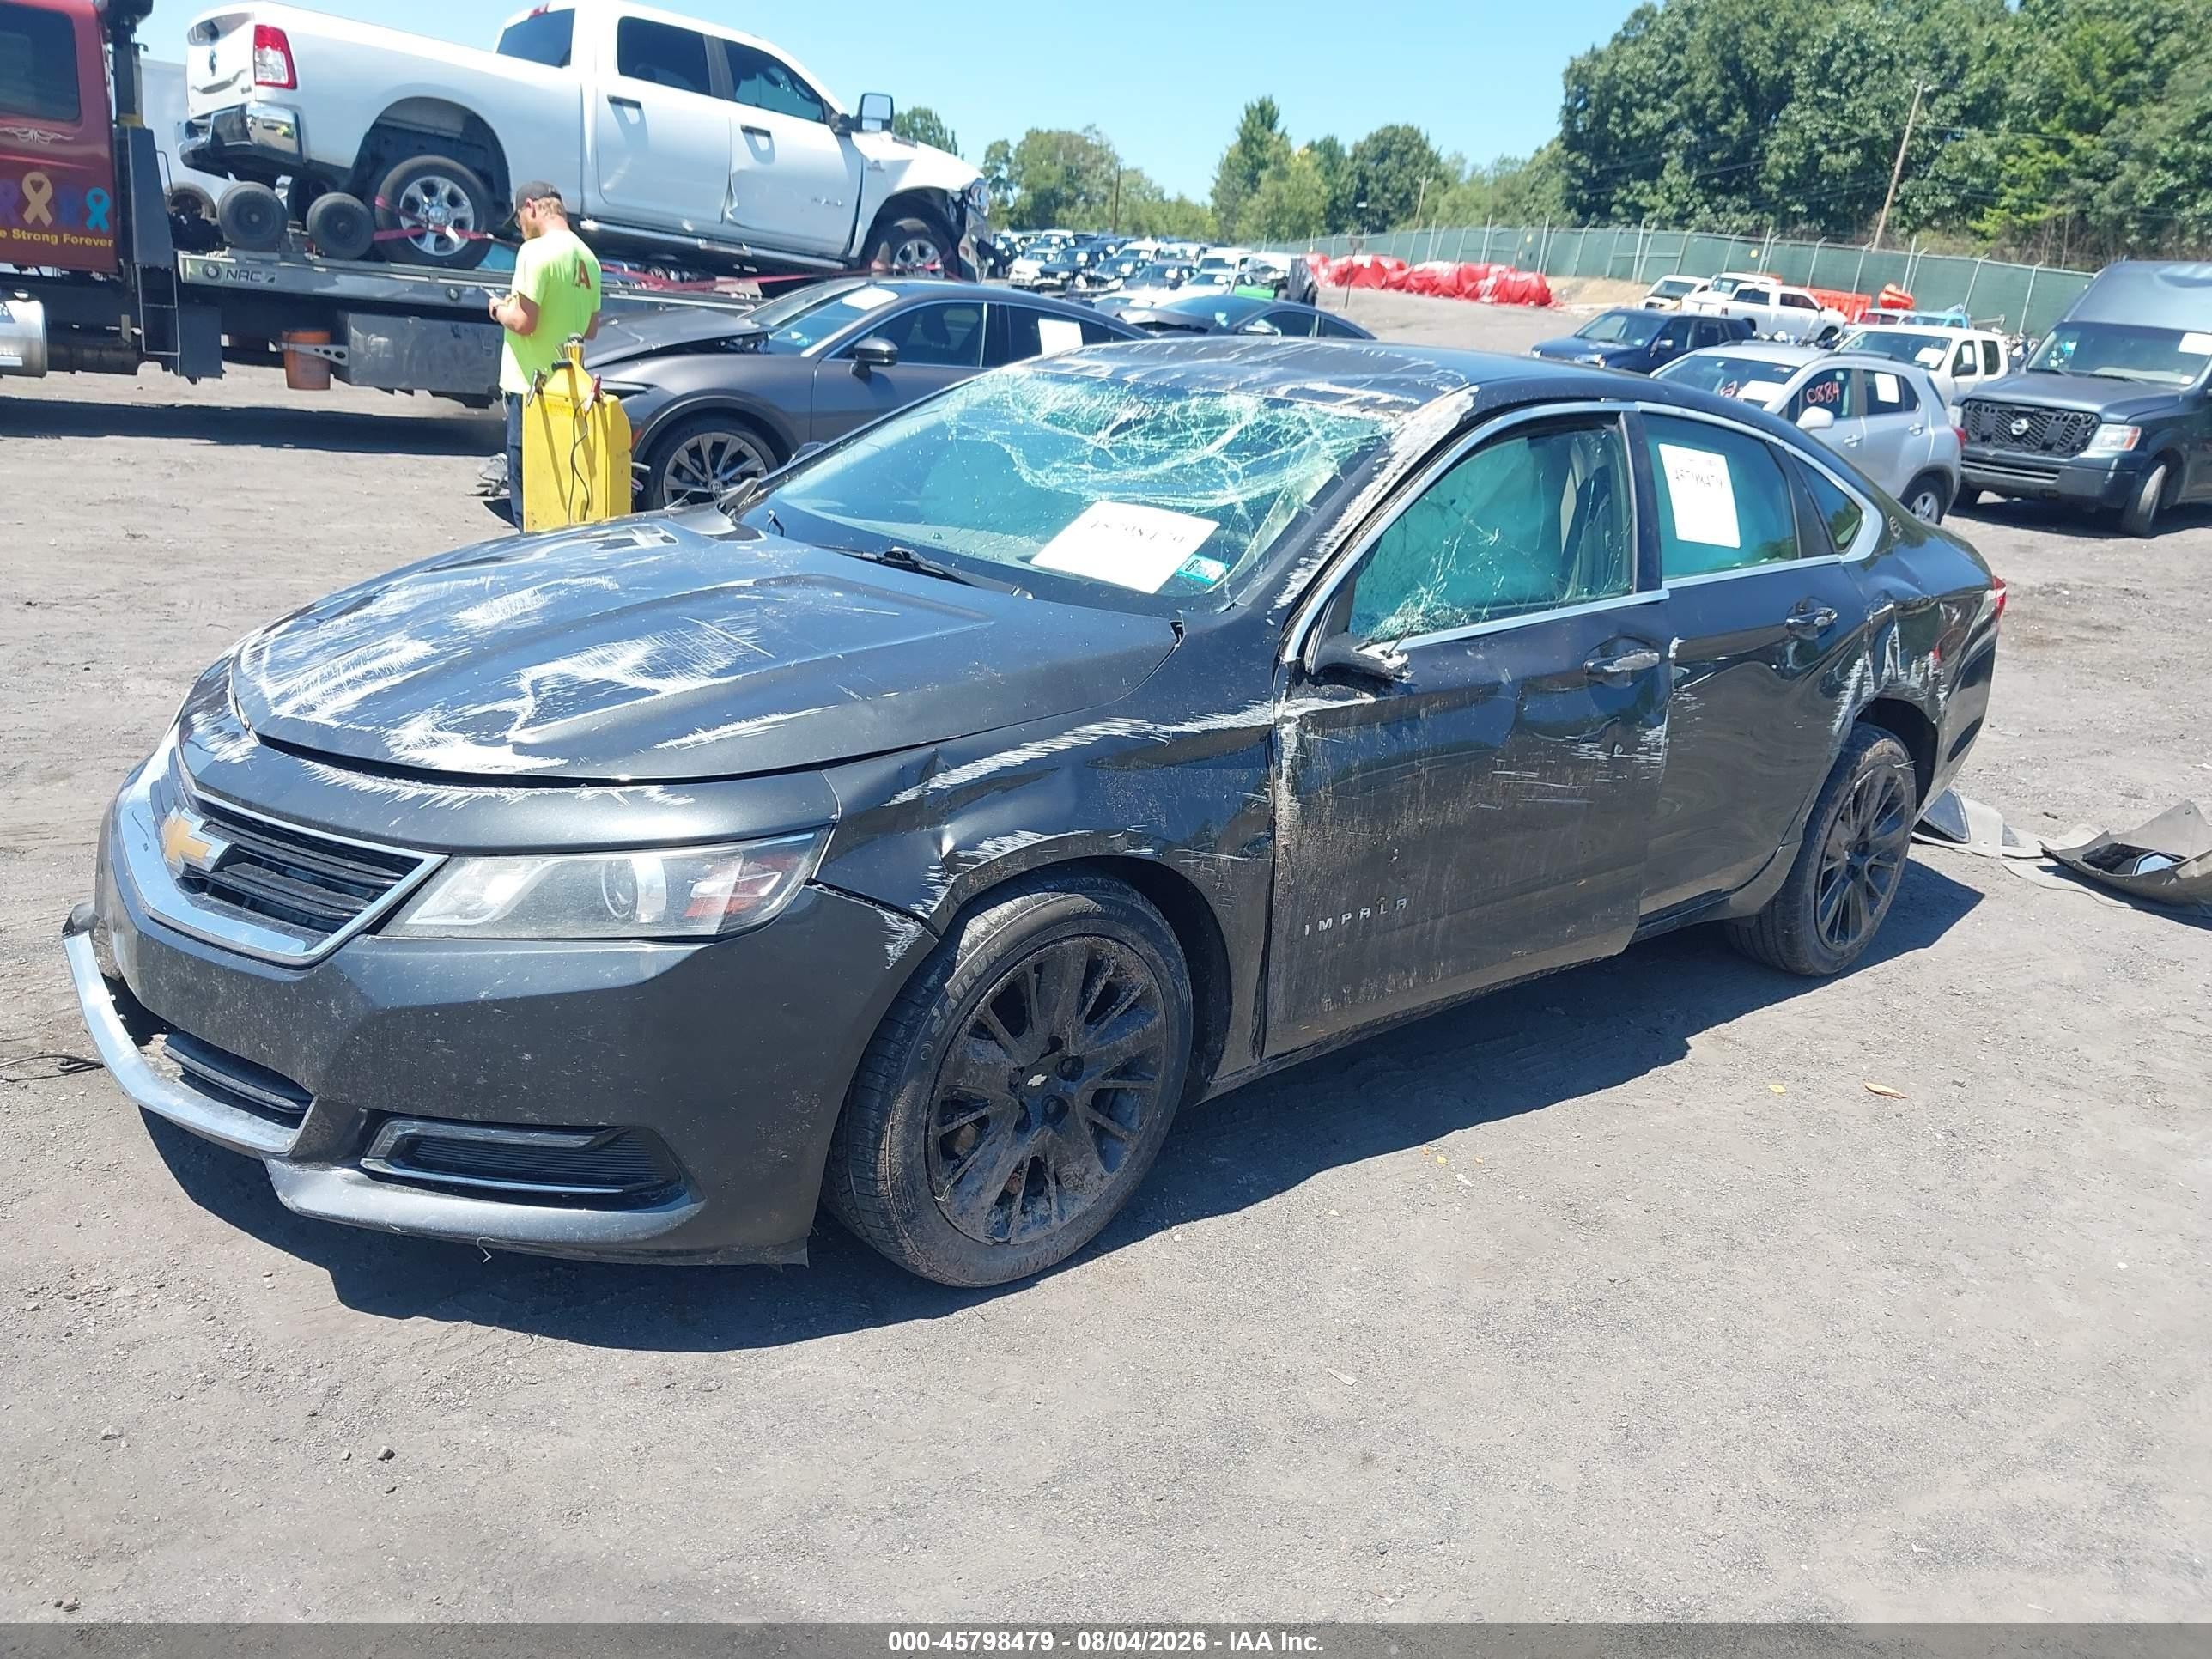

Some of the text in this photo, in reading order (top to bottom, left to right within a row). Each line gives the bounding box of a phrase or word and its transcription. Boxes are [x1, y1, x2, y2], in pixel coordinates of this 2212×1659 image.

[11, 228, 58, 246] Strong
[63, 233, 114, 247] Forever
[1806, 380, 1840, 404] 0884
[1304, 896, 1408, 936] IMPALA
[931, 941, 1002, 1038] SAILUN
